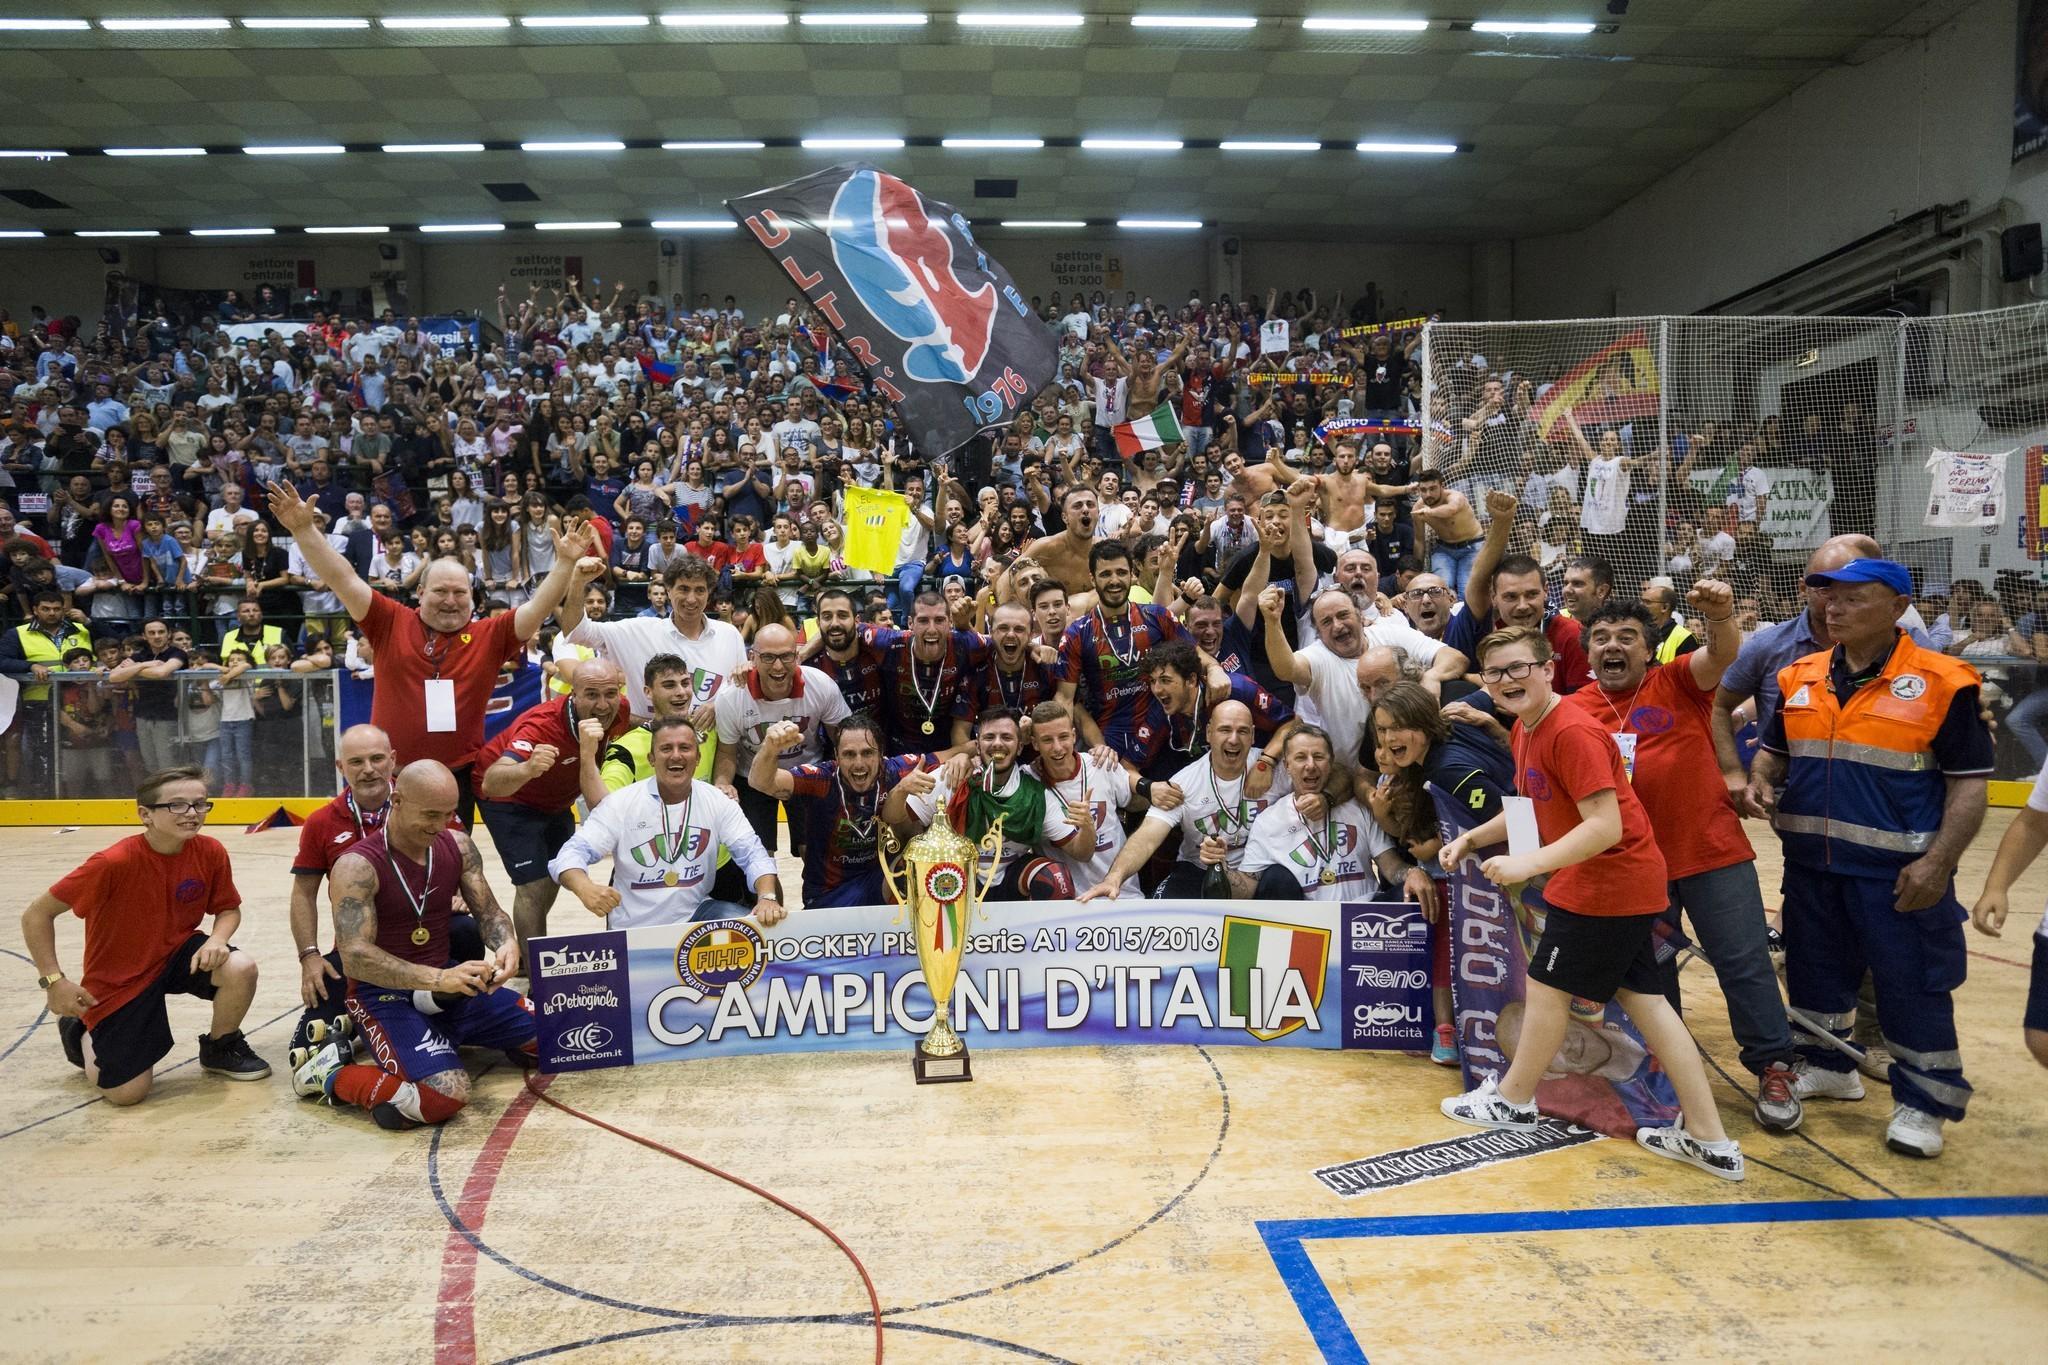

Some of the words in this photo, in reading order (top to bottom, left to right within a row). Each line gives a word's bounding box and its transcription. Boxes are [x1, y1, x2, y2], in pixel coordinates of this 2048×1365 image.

[515, 255, 562, 265] settore
[1056, 250, 1102, 261] settore
[243, 269, 295, 281] centrale
[510, 266, 562, 277] centrale
[1050, 262, 1104, 273] laterale
[963, 366, 1029, 425] 1976
[699, 678, 715, 692] 3
[688, 834, 701, 851] 3
[1337, 829, 1348, 847] 3
[684, 864, 702, 879] TRE
[1337, 860, 1358, 874] TRE
[684, 922, 720, 949] ITALIANA
[721, 921, 756, 937] HOCKEY
[755, 932, 875, 964] HOCKEY
[882, 931, 918, 957] PIS
[1032, 927, 1067, 953] A1
[1075, 925, 1220, 954] 2015/2016
[696, 946, 749, 970] FIHP
[550, 964, 588, 976] canale
[592, 961, 609, 971] 89
[680, 948, 710, 994] FEDERAZIONE
[1348, 964, 1428, 990] Reno
[551, 989, 619, 1012] Petrognola
[1044, 964, 1323, 1033] D'ITALIA
[1353, 1026, 1424, 1039] pubblicità
[550, 1048, 623, 1064] sicetelecom.it
[1320, 1142, 1475, 1192] RESIDENZIALI
